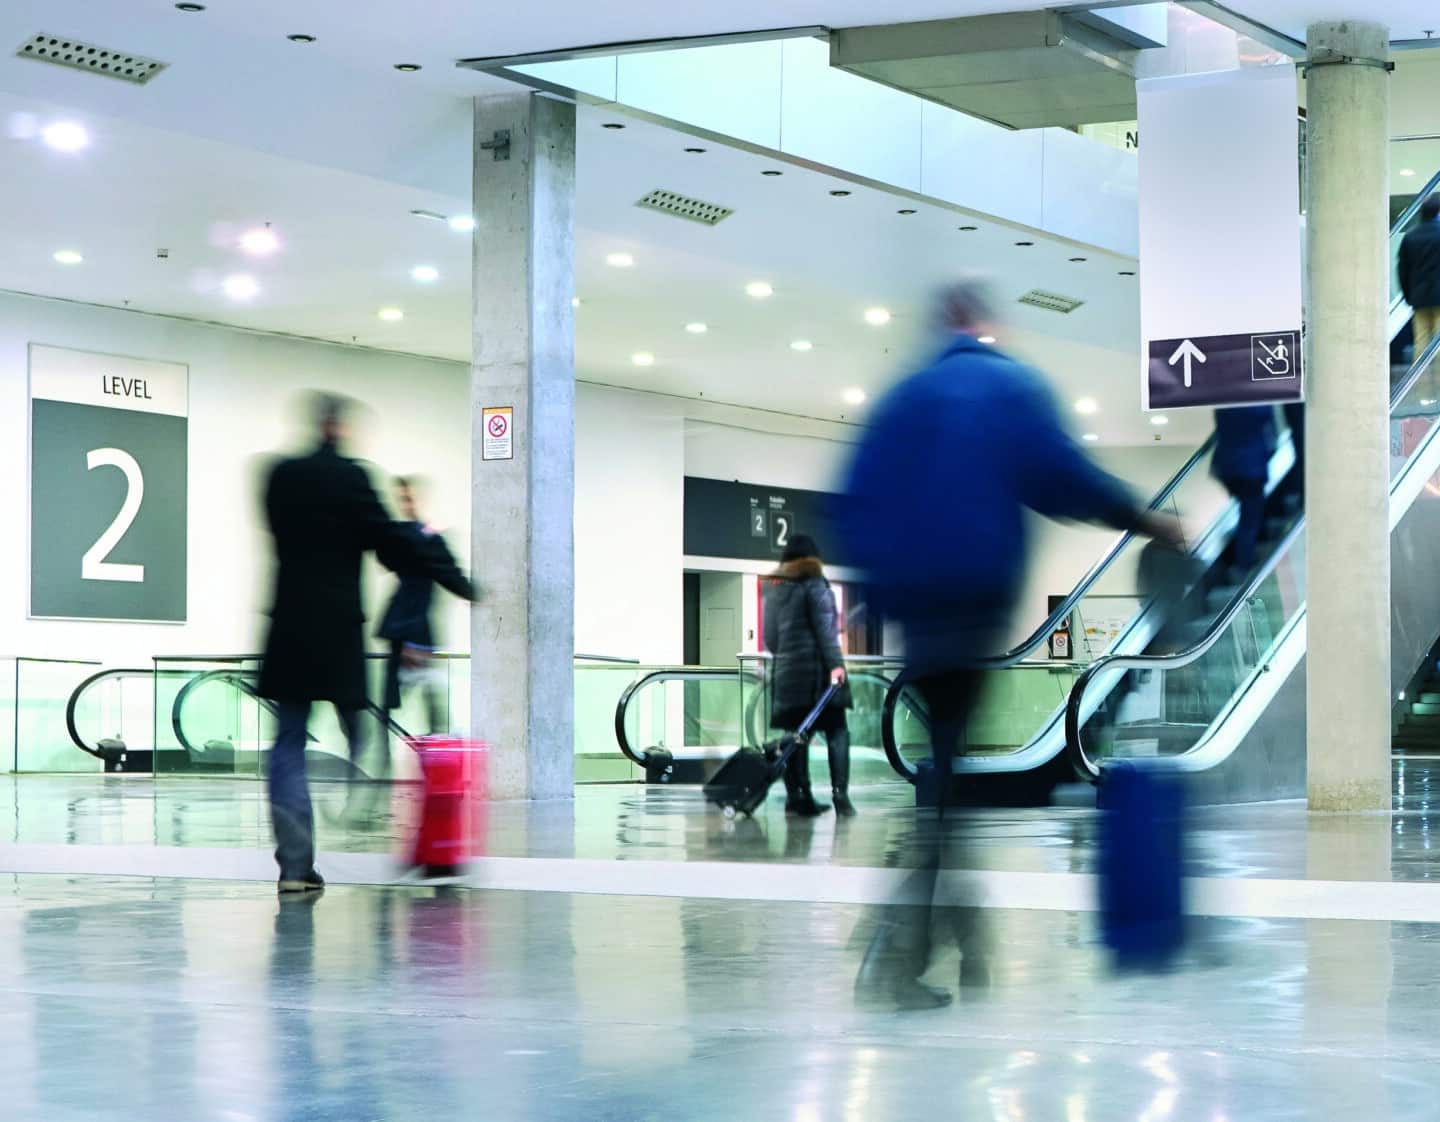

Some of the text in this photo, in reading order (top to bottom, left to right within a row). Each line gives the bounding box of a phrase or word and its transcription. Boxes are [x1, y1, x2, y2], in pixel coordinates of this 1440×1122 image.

[103, 374, 153, 400] LEVEL
[80, 446, 145, 583] 2
[756, 515, 763, 531] 2
[777, 517, 788, 546] 2
